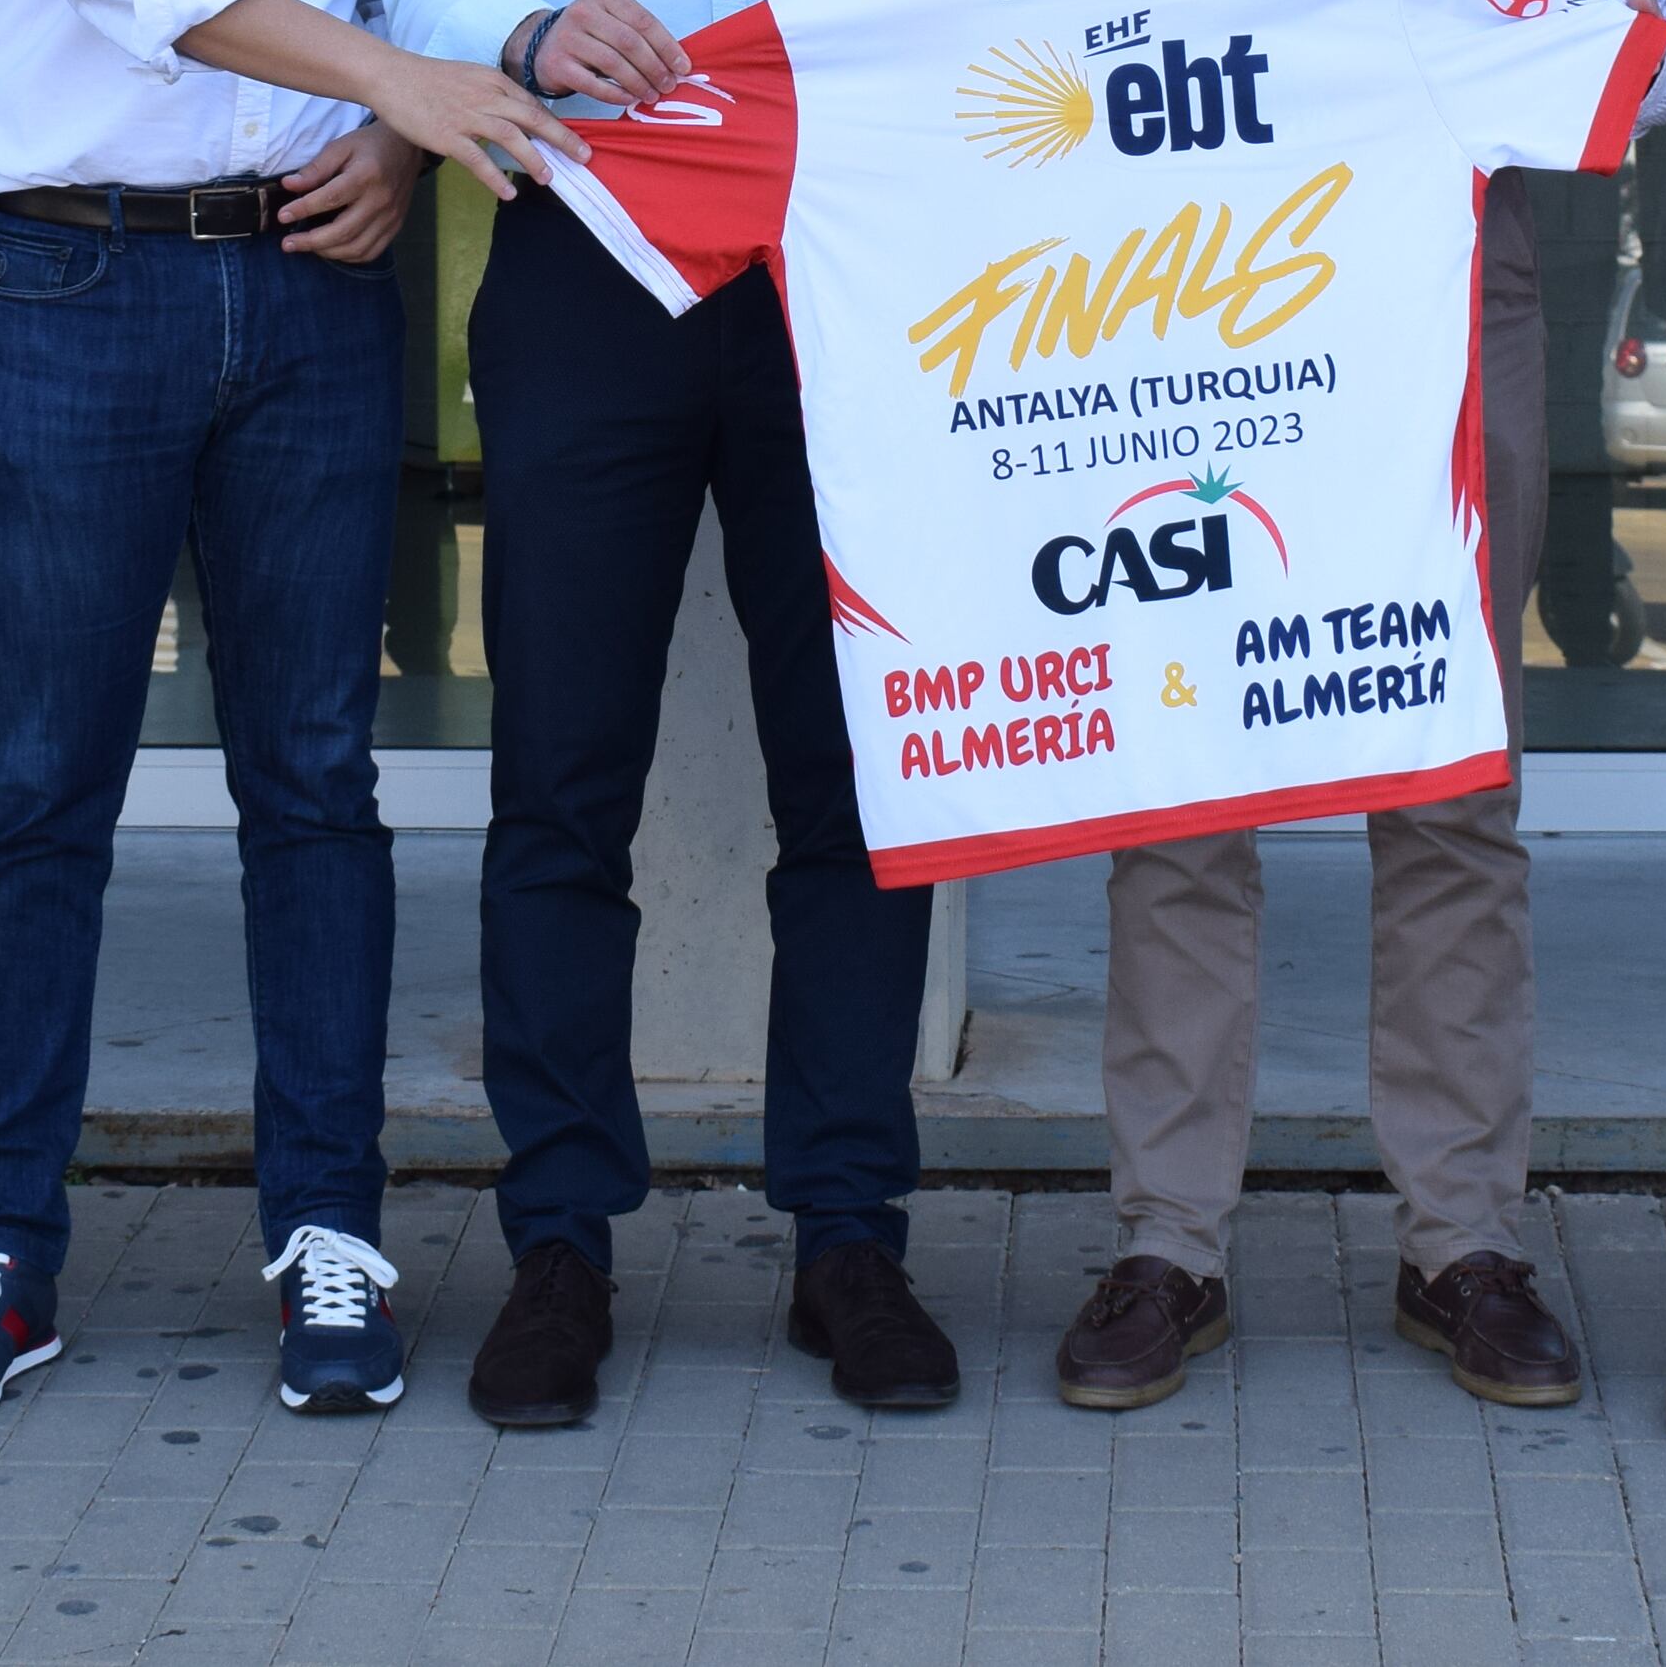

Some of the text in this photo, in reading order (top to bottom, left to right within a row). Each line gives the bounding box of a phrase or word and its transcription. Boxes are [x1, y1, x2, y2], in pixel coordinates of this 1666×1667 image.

[1085, 9, 1151, 51] EHF
[1106, 34, 1274, 157] ebt
[908, 161, 1354, 399] FINALS
[949, 353, 1337, 433] ANTALYA (TURQUIA)
[991, 411, 1304, 481] 8-11 JUNIO 2023
[1031, 513, 1234, 616] CASI
[1236, 599, 1451, 668] AM TEAM
[884, 643, 1113, 718] BMP URCI
[1161, 661, 1198, 708] &
[1242, 651, 1447, 731] ALMERÍA
[901, 699, 1116, 781] ALMERÍA
